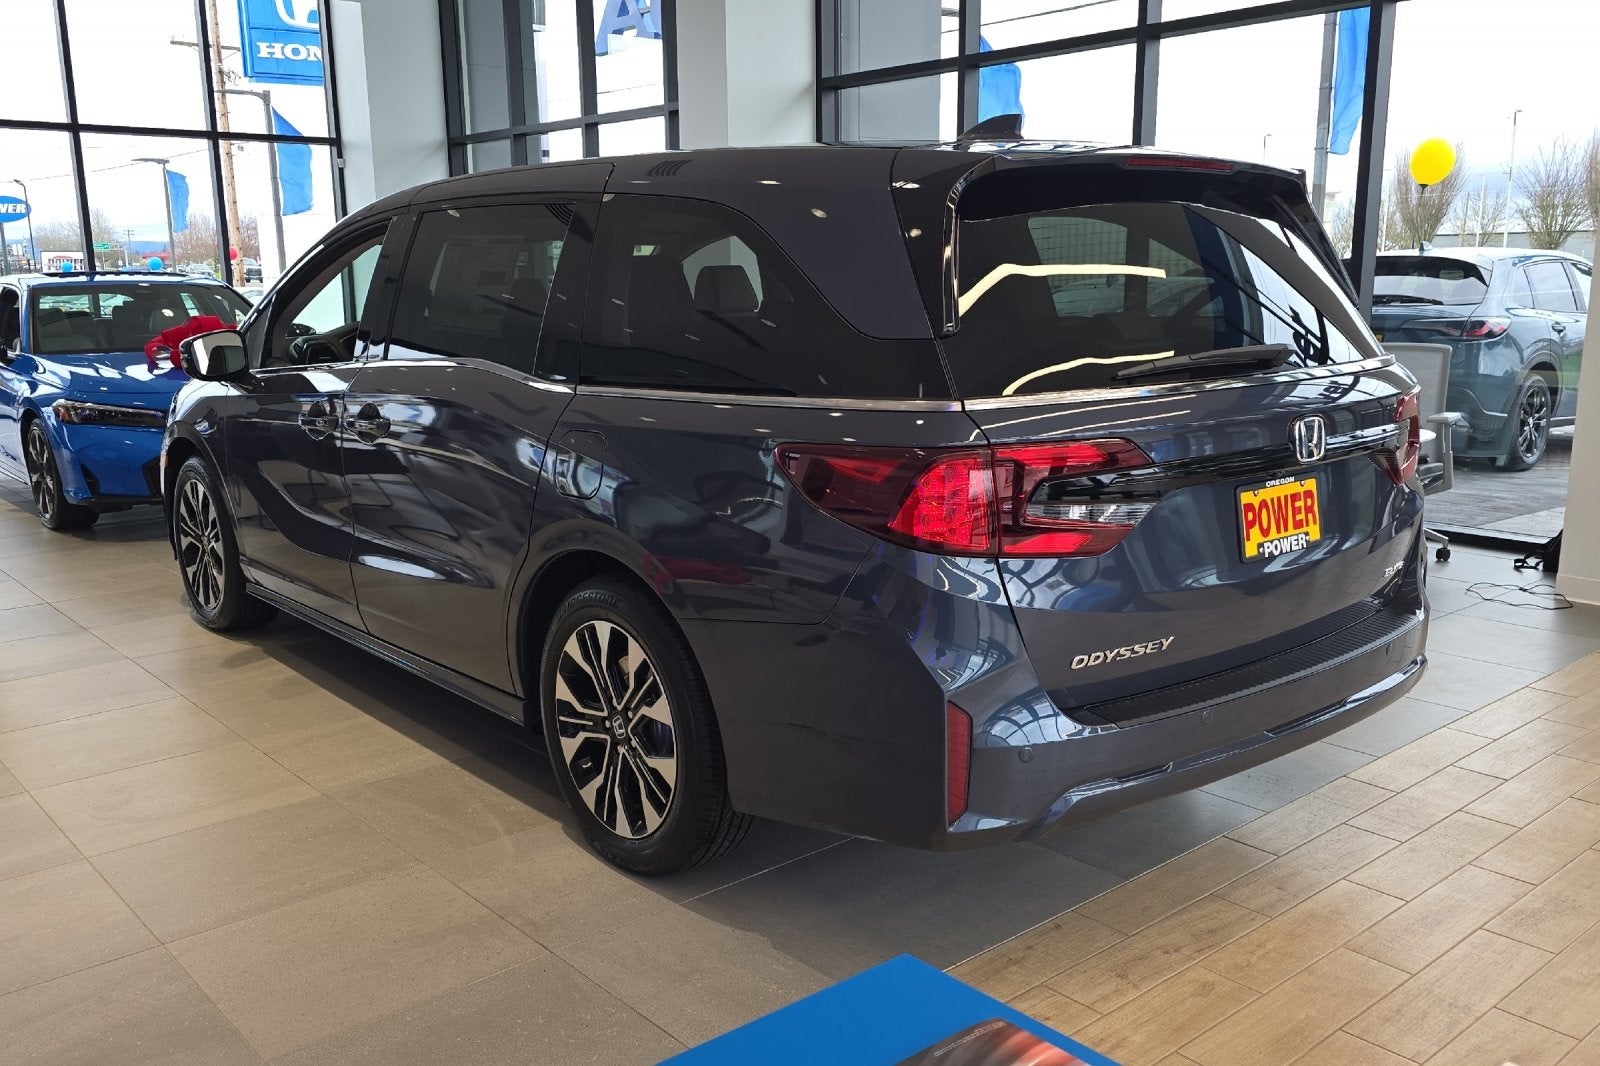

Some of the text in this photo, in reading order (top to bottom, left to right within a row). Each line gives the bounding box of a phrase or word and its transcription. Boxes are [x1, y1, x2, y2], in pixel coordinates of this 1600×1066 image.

[1265, 476, 1295, 488] OREGON
[1243, 490, 1317, 542] POWER
[1263, 533, 1307, 558] POWER
[1070, 635, 1175, 670] ODYSSEY
